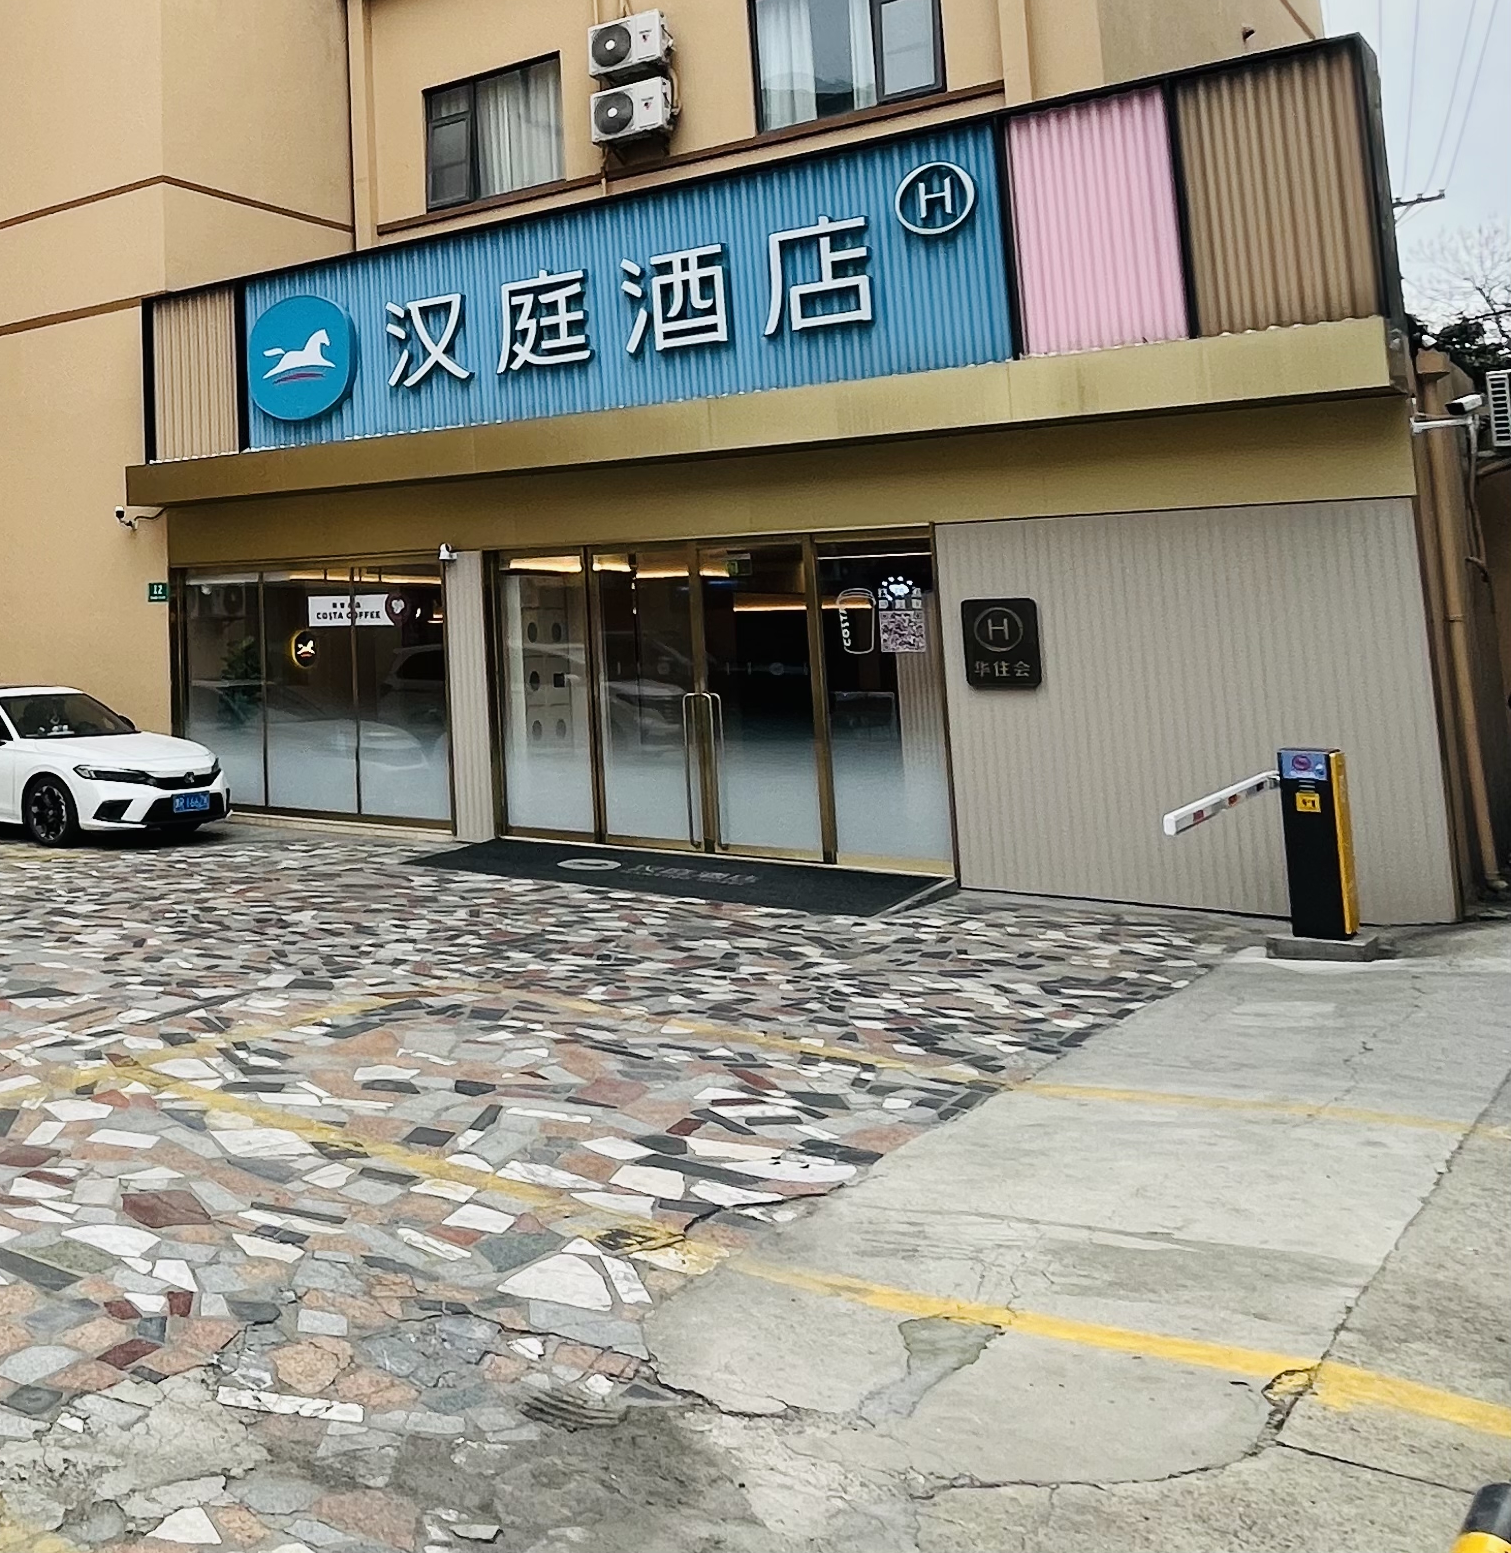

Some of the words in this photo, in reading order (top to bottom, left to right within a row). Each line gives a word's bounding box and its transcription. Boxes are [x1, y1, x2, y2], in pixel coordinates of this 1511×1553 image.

[384, 213, 874, 388] 汉庭酒店
[316, 611, 344, 620] COSTA
[974, 659, 1031, 678] 华住会
